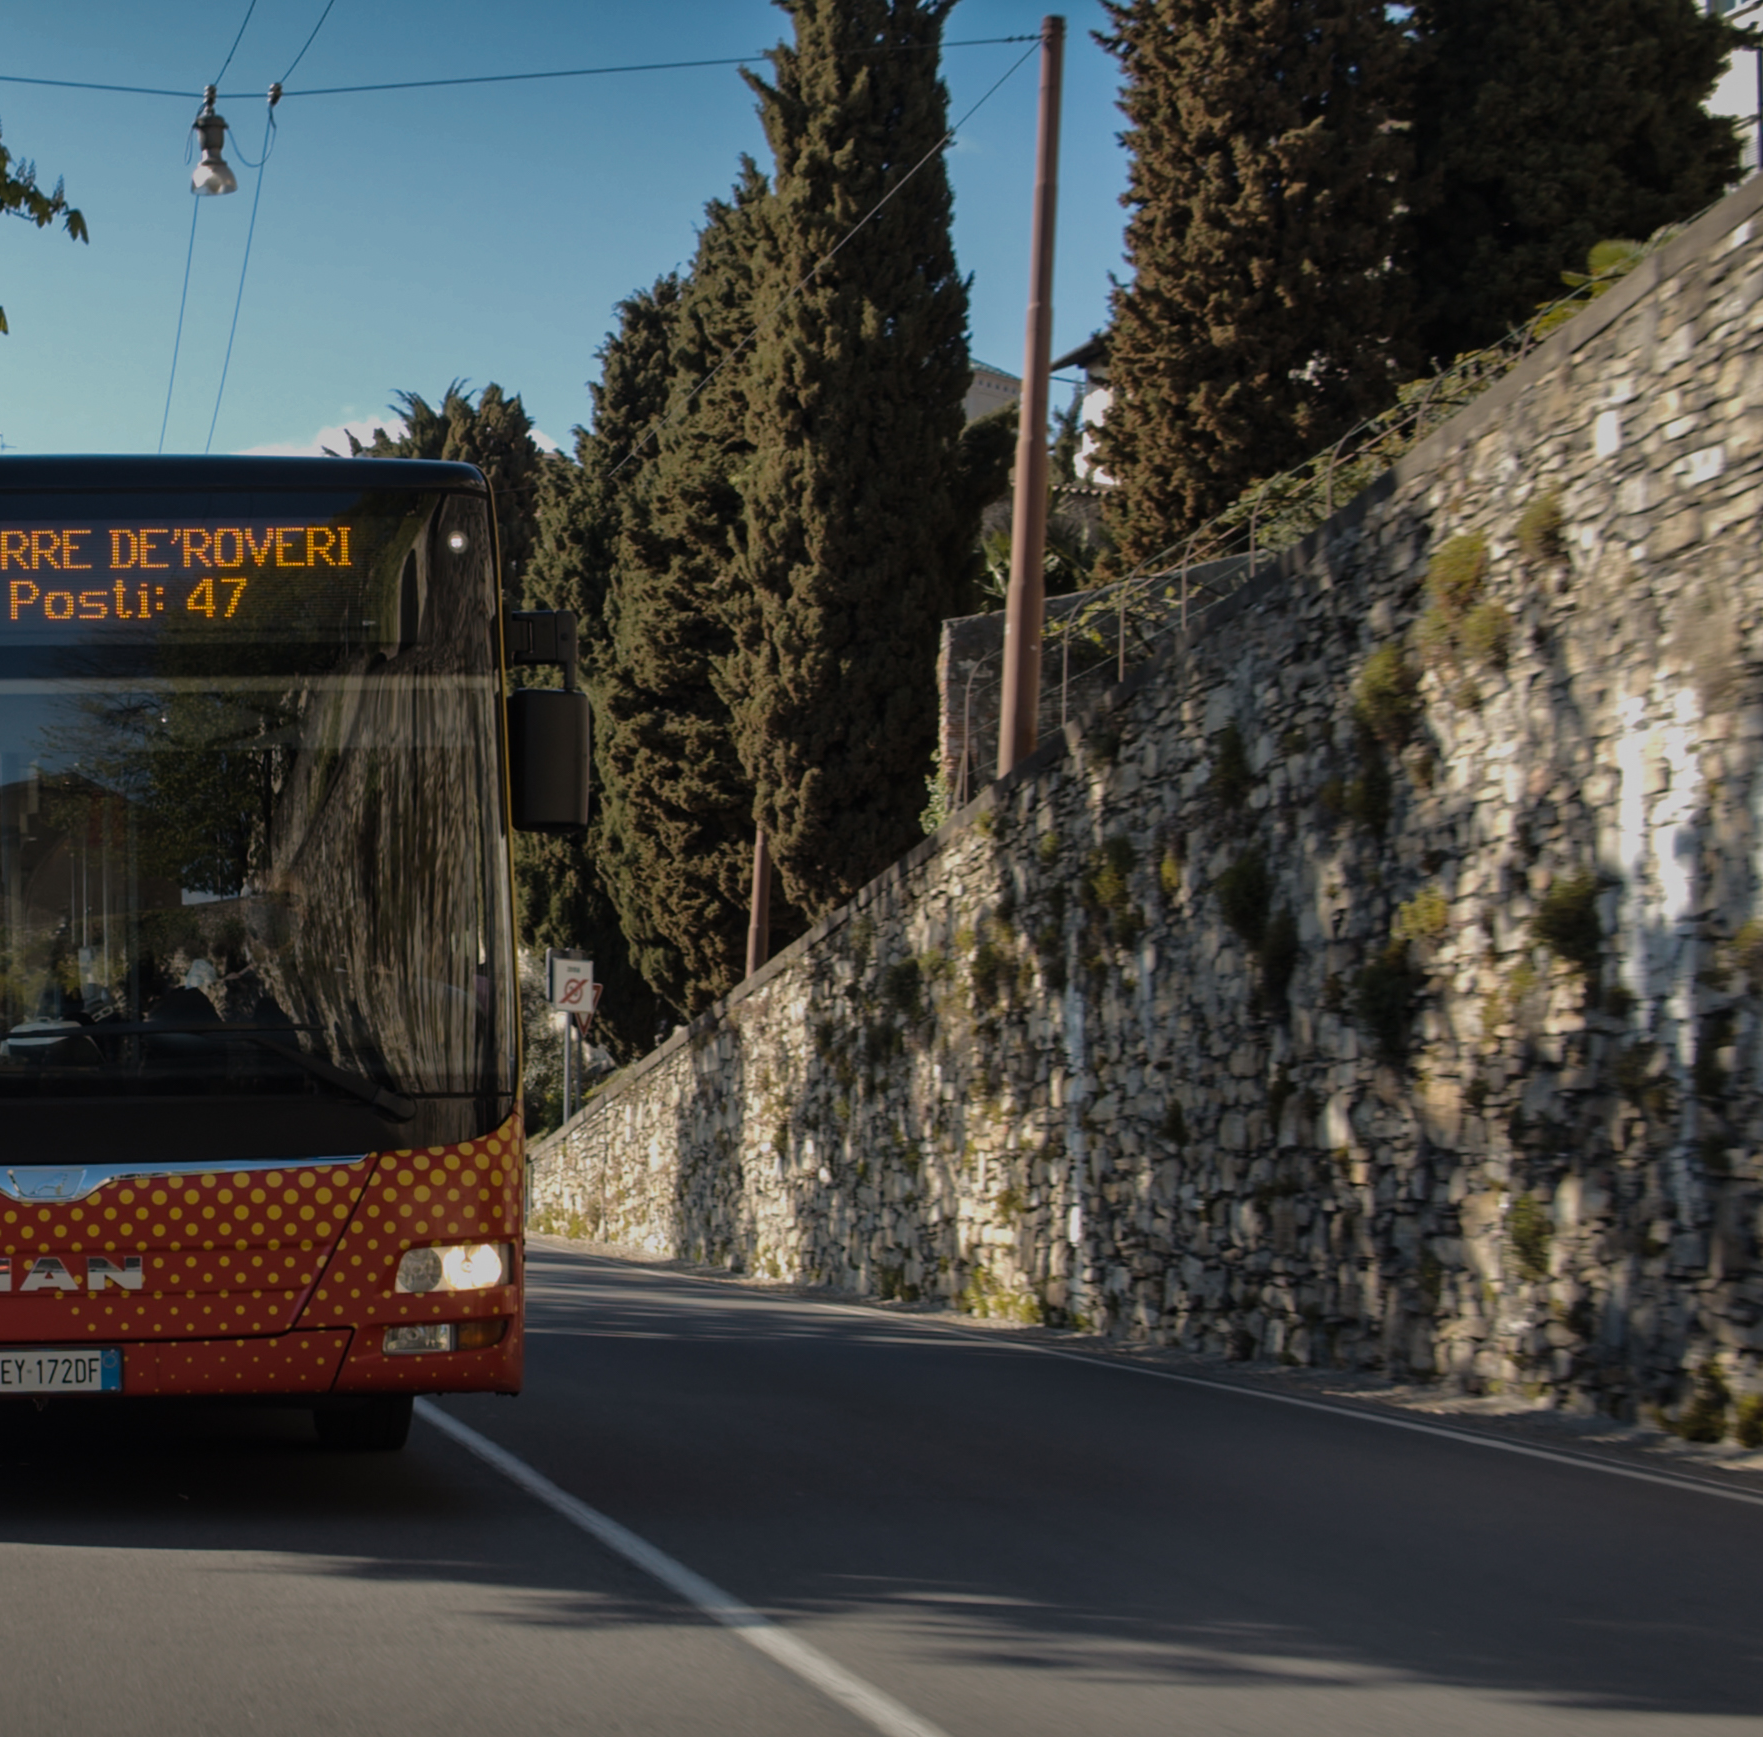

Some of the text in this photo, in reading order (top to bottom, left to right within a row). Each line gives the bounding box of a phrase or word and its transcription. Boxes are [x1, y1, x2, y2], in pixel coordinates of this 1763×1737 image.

[109, 527, 352, 568] DE'ROVERI
[10, 578, 247, 619] Posti: 47
